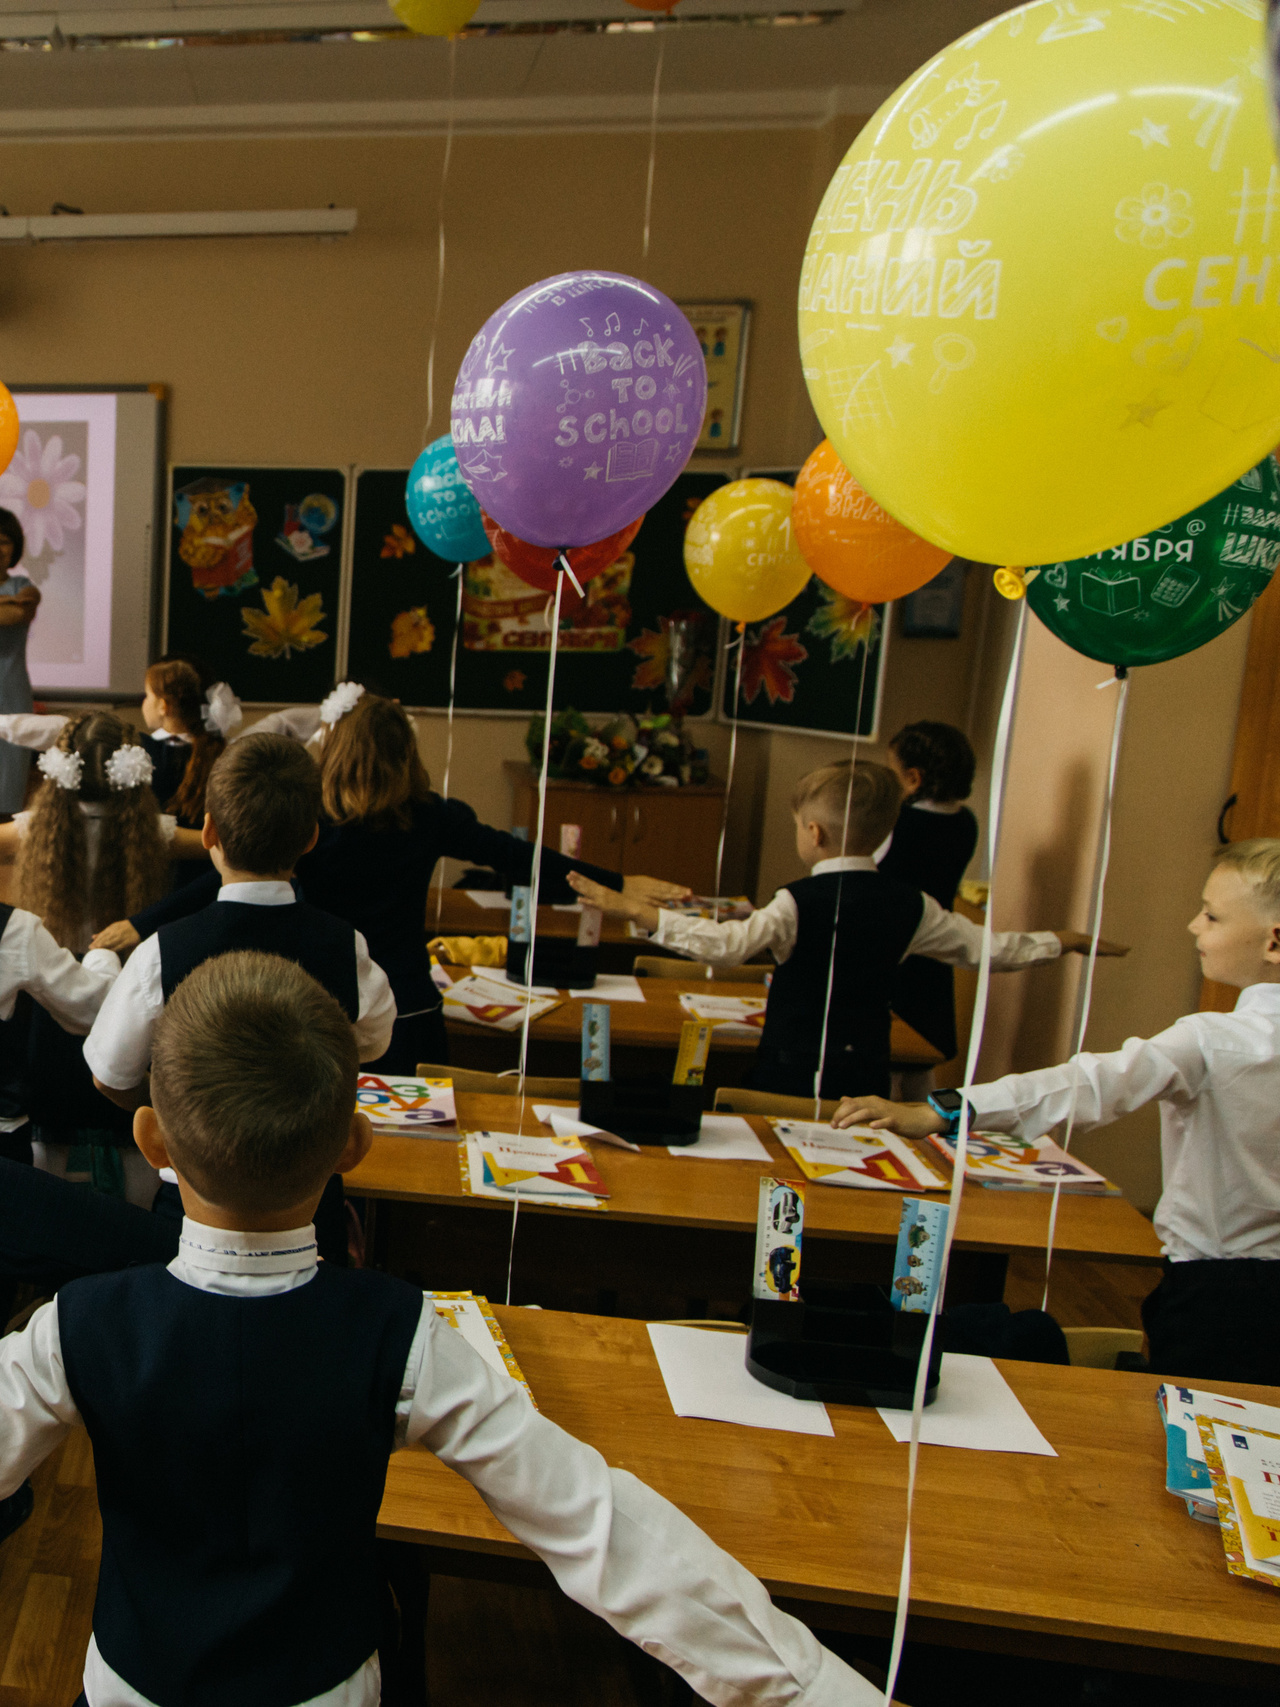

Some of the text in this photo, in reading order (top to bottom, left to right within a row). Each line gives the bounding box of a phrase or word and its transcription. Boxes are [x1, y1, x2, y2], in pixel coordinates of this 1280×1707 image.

[806, 158, 978, 252] ЕНЬ
[799, 239, 1002, 320] АНИЙ
[1143, 256, 1280, 311] СЕН
[611, 374, 657, 403] TO
[451, 414, 507, 447] ОЛА!
[1086, 537, 1195, 563] ЯБРЯ
